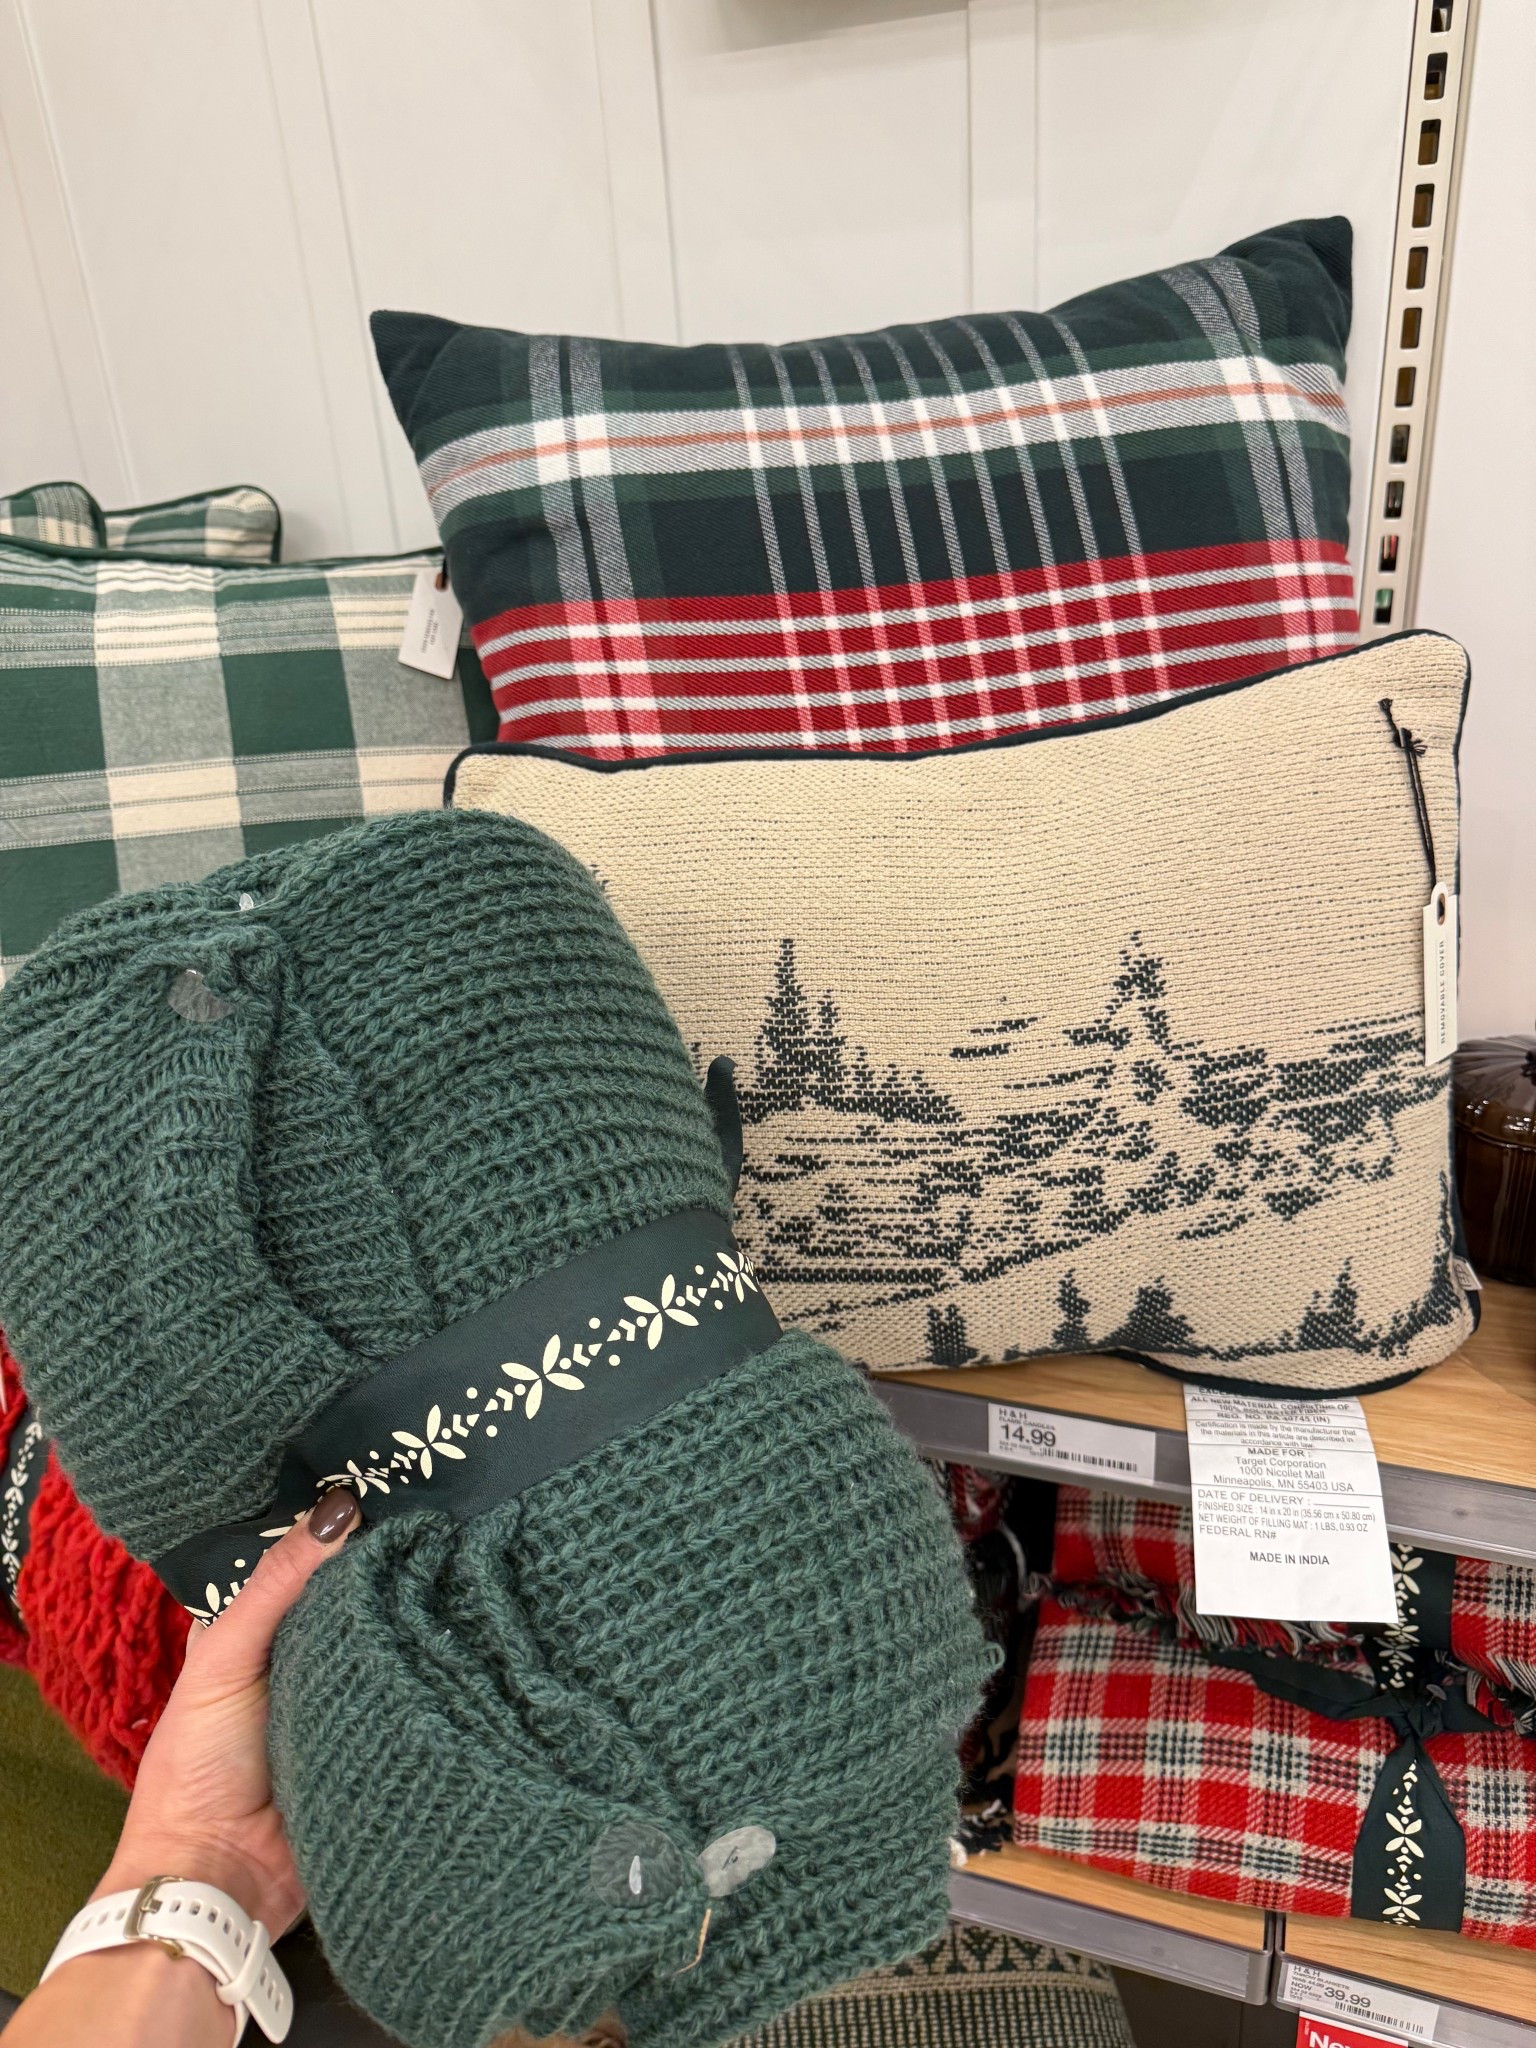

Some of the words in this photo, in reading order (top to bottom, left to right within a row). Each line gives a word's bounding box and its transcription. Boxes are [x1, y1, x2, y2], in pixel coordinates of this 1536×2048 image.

[1233, 1399, 1279, 1410] MATERIAL
[999, 1408, 1007, 1416] H
[1019, 1411, 1027, 1420] H
[1001, 1423, 1056, 1447] 14.99
[1195, 1421, 1239, 1429] Certification
[1270, 1424, 1278, 1432] by
[1280, 1424, 1292, 1432] the
[1293, 1425, 1340, 1435] manufacturer
[1310, 1435, 1345, 1443] described
[1248, 1448, 1279, 1456] MADE
[1282, 1449, 1305, 1457] FOR
[1235, 1456, 1267, 1467] Target
[1269, 1458, 1327, 1469] Corporation
[1240, 1466, 1263, 1476] 1000
[1266, 1467, 1303, 1479] Nicollet
[1305, 1470, 1326, 1480] Mall
[1214, 1475, 1275, 1489] Minneapolis,
[1278, 1479, 1295, 1489] MN
[1298, 1480, 1328, 1491] 55403
[1331, 1482, 1355, 1492] USA
[1198, 1489, 1228, 1500] DATE
[1231, 1491, 1246, 1501] OF
[1249, 1493, 1304, 1505] DELIVERY
[1198, 1501, 1235, 1512] FINISHED
[1236, 1504, 1254, 1514] SIZE
[1260, 1506, 1268, 1515] 14
[1270, 1507, 1276, 1515] in
[1283, 1507, 1292, 1517] 20
[1293, 1508, 1299, 1517] in
[1323, 1512, 1335, 1520] cm
[1341, 1511, 1361, 1521] 50.80
[1362, 1513, 1376, 1523] cm)
[1199, 1513, 1214, 1522] NET
[1216, 1514, 1247, 1525] WEIGHT
[1249, 1516, 1260, 1526] OF
[1261, 1518, 1291, 1529] FILLING
[1293, 1520, 1309, 1530] MAT
[1340, 1523, 1355, 1532] 0.93
[1357, 1523, 1369, 1533] OZ
[1199, 1525, 1252, 1538] FEDERAL
[1254, 1529, 1277, 1540] RN#
[1250, 1551, 1282, 1564] MADE
[1285, 1554, 1296, 1565] IN
[1299, 1555, 1330, 1565] INDIA
[1291, 1981, 1313, 1991] NOW
[1324, 1987, 1372, 2009] 39.99
